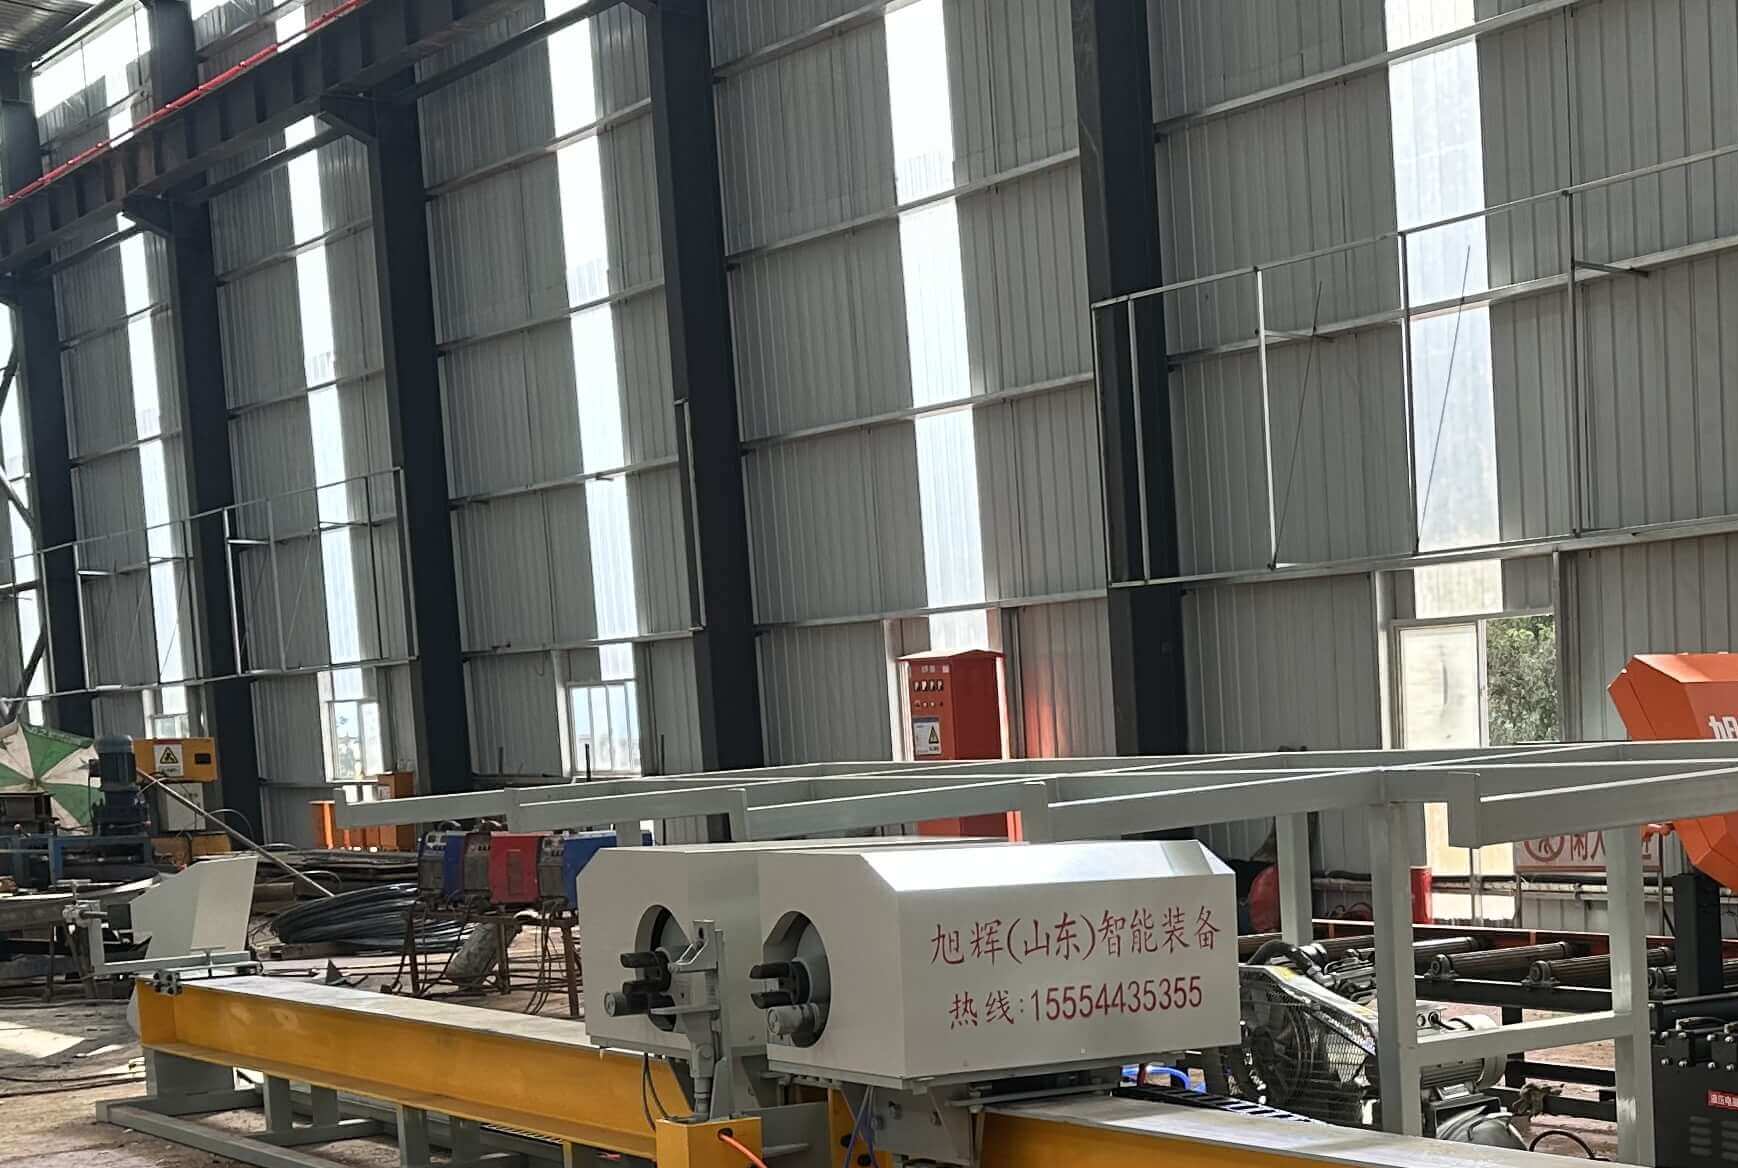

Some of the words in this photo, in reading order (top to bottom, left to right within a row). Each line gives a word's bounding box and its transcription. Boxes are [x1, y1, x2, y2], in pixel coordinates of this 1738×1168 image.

[929, 905, 1221, 965] 旭辉(山东)智能装备
